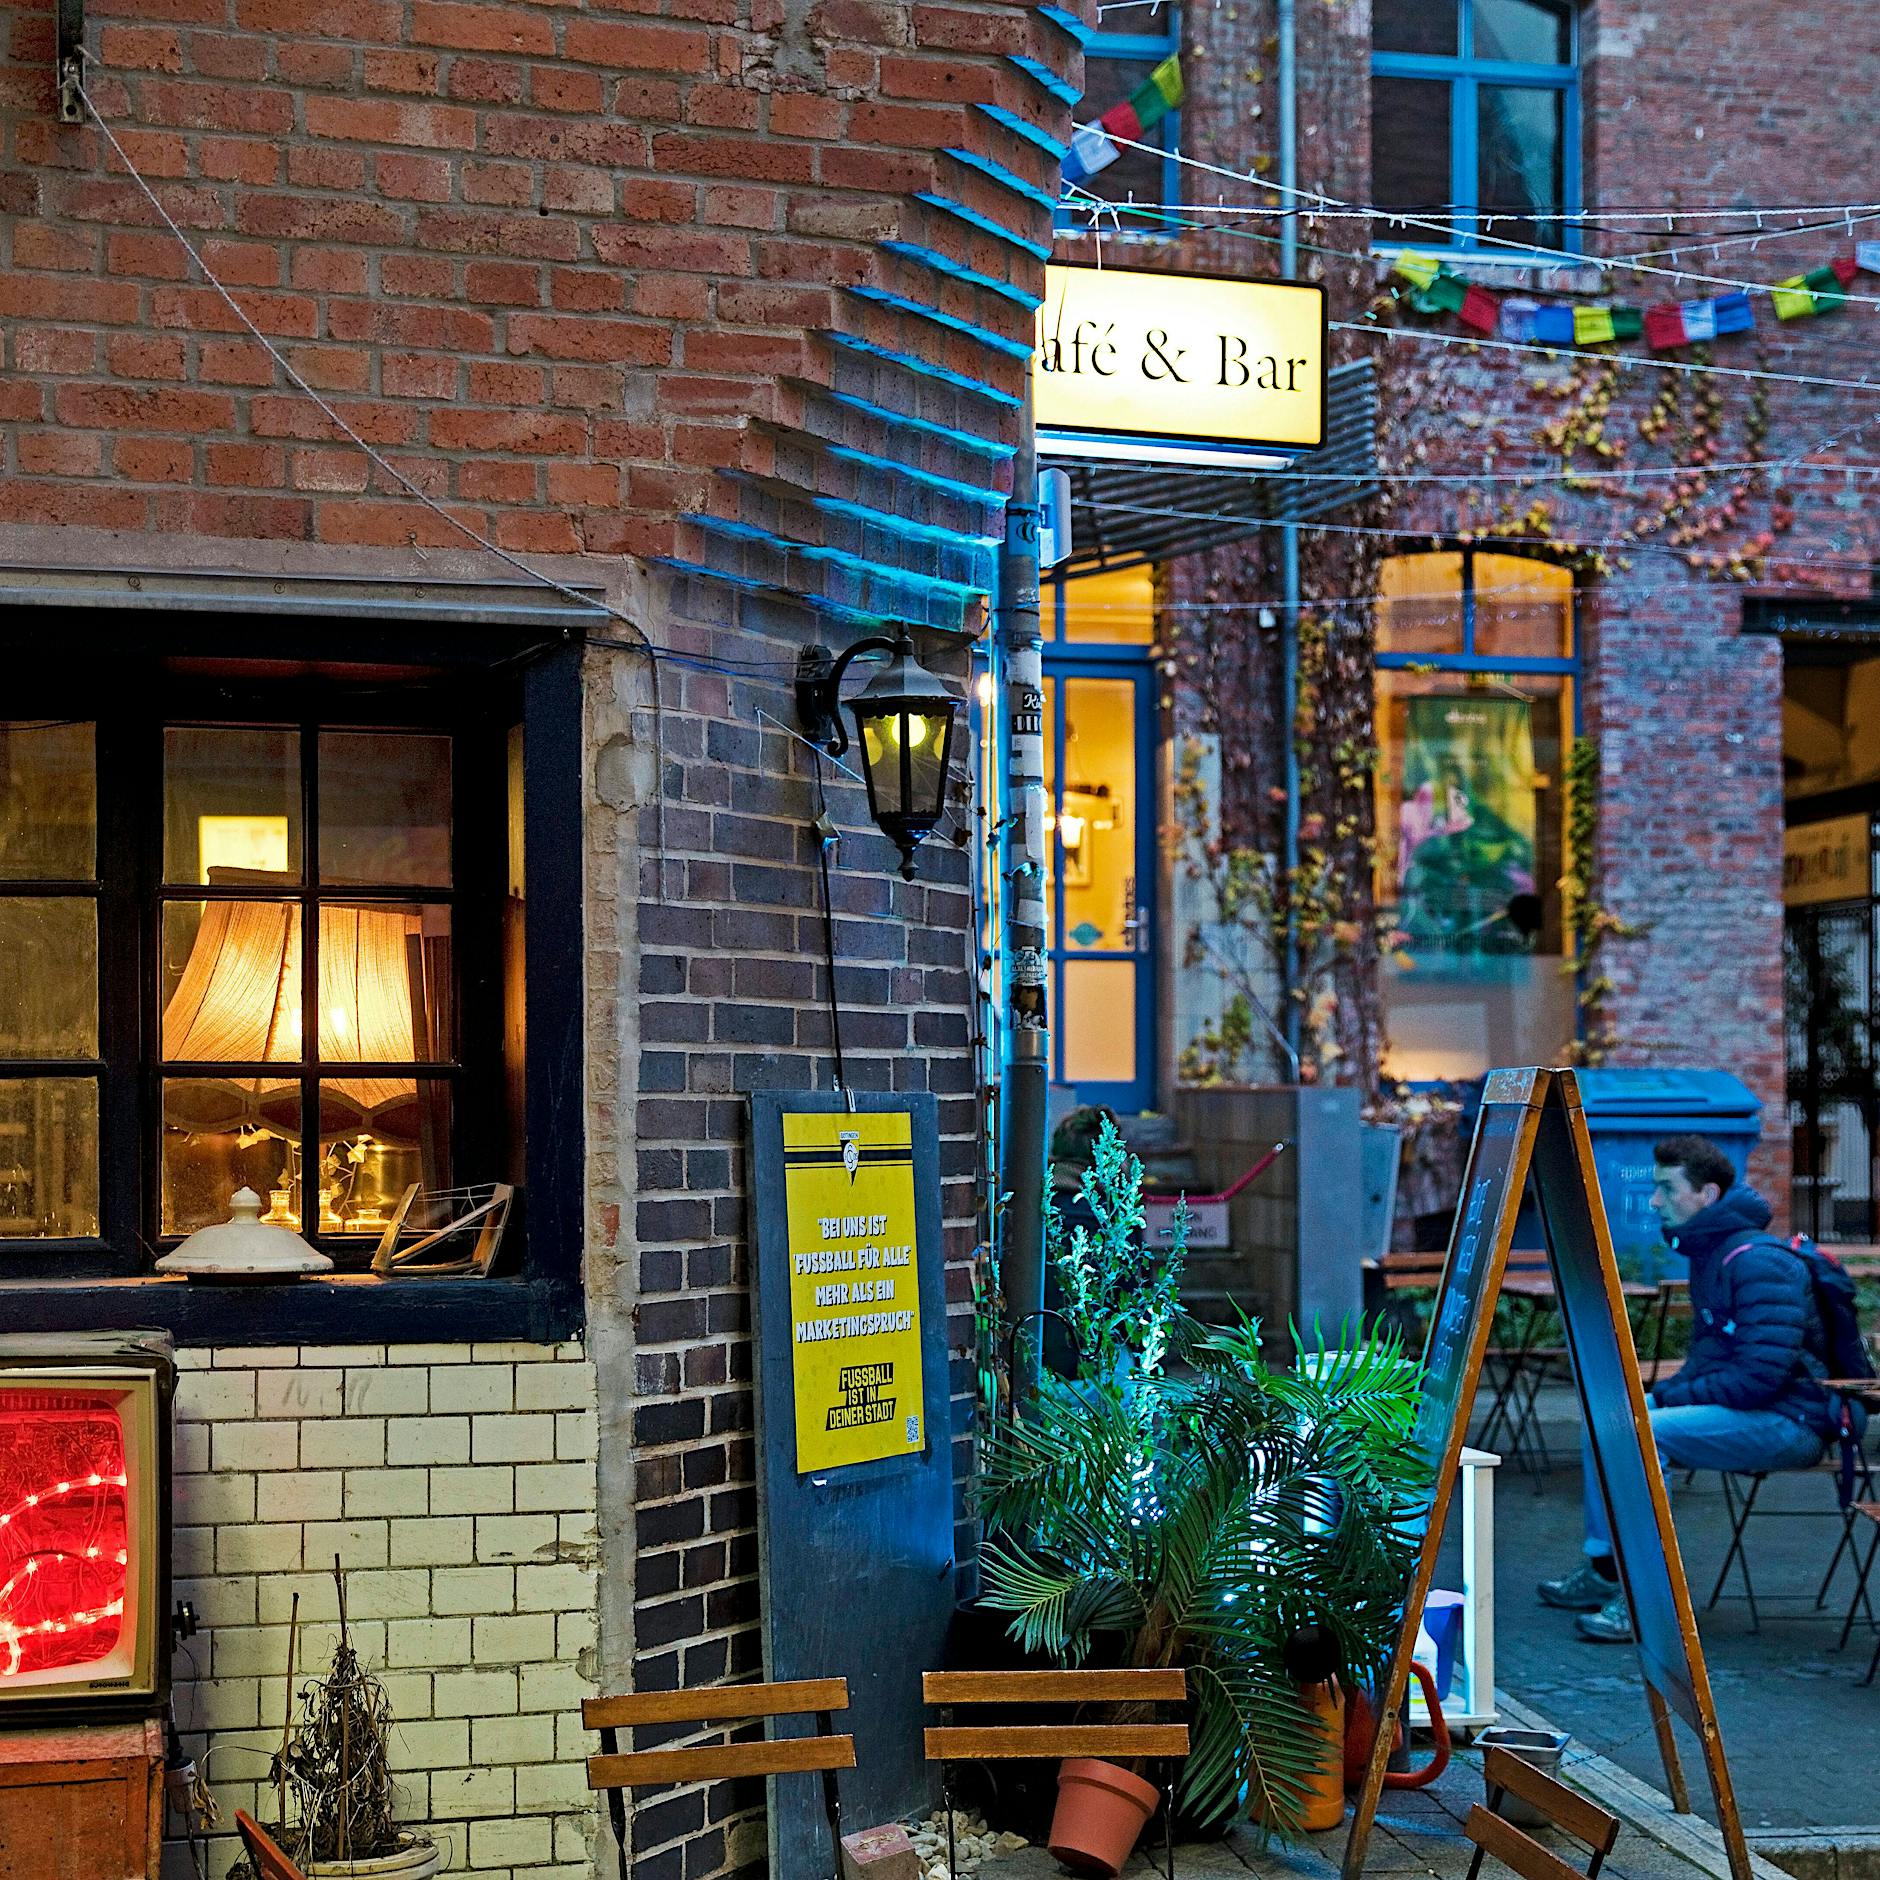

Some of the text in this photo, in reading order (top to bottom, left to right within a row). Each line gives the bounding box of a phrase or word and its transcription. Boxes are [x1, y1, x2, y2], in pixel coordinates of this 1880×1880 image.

[1041, 320, 1307, 393] afé & Bar
[842, 1216, 867, 1239] UNS
[868, 1215, 888, 1236] IST
[857, 1243, 881, 1270] FÜR
[815, 1279, 895, 1307] MEHR ALS EIN
[841, 1364, 893, 1390] FUSSBALL
[848, 1386, 876, 1406] IST IN
[829, 1400, 894, 1429] DEINER STADT
